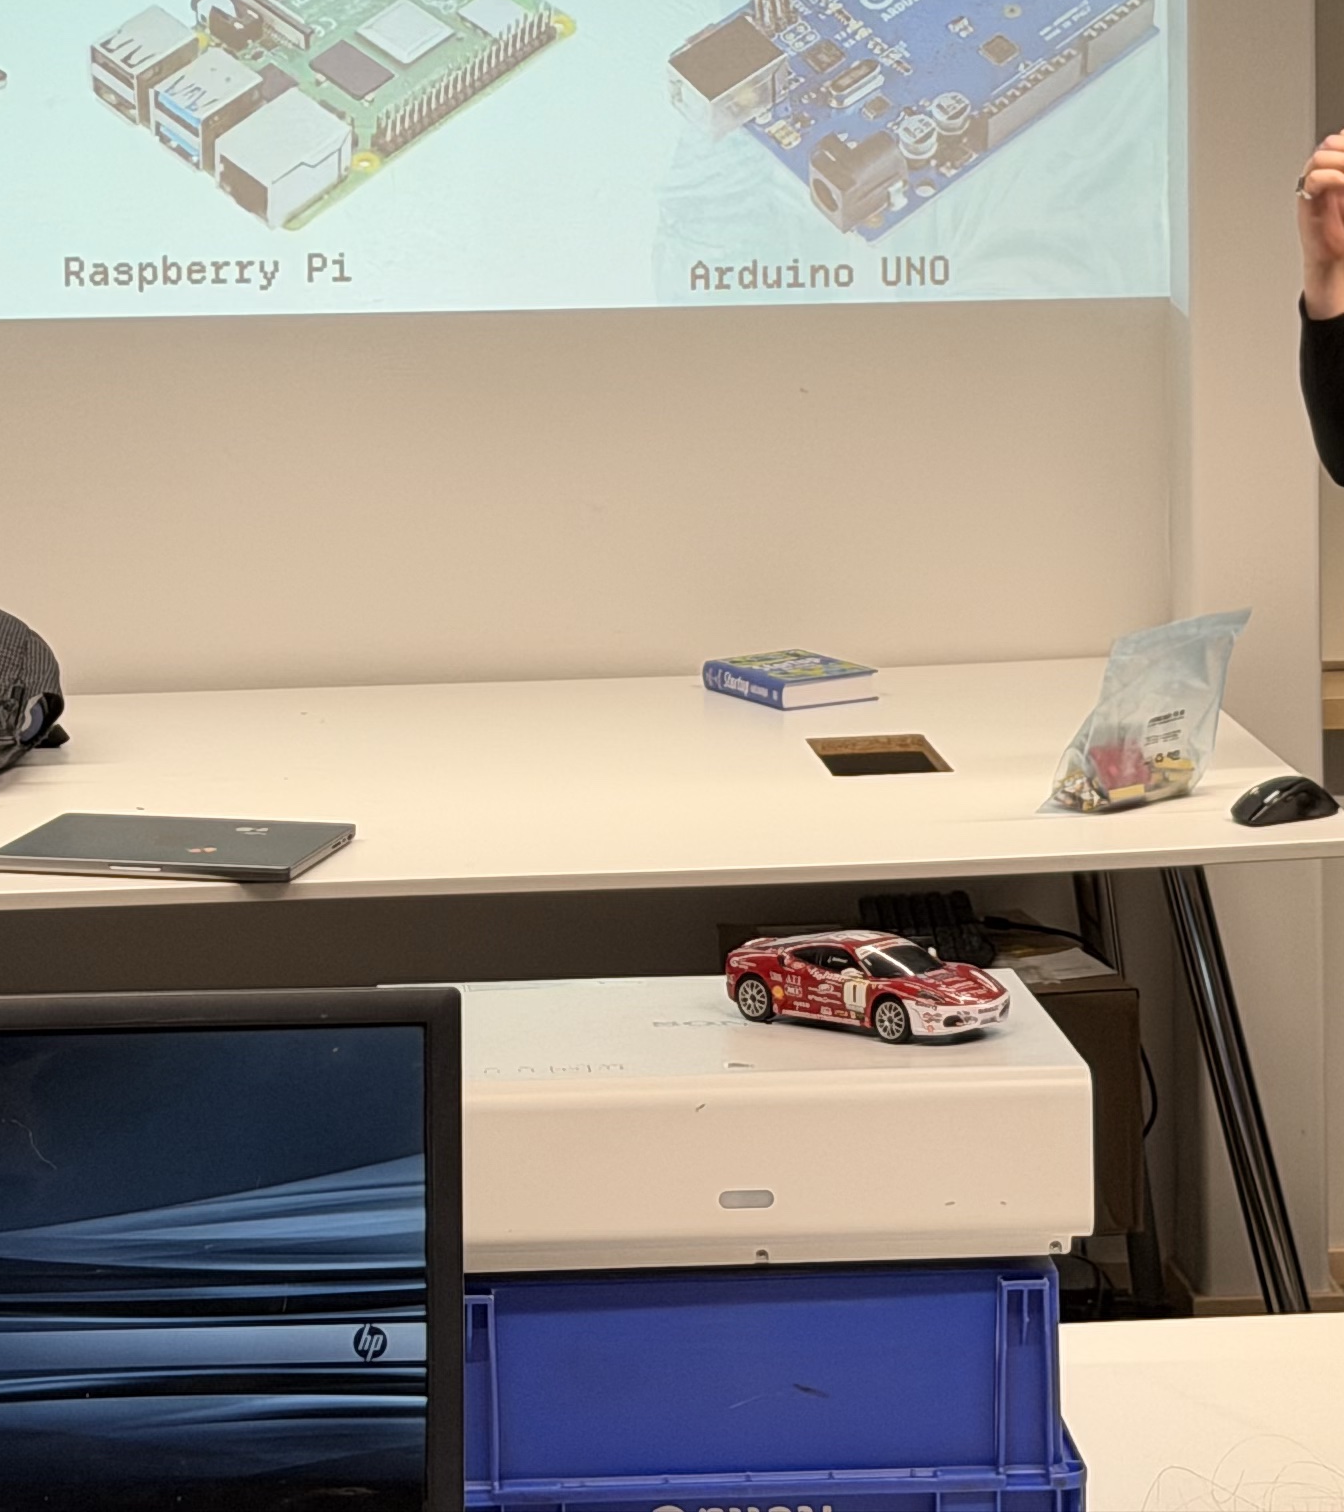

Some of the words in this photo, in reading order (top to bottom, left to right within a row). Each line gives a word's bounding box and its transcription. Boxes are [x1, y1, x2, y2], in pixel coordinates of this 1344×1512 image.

[63, 254, 280, 292] Raspberry
[306, 253, 353, 284] Pi
[690, 258, 854, 291] Arduino
[881, 255, 950, 286] UNO
[358, 1323, 383, 1362] hp
